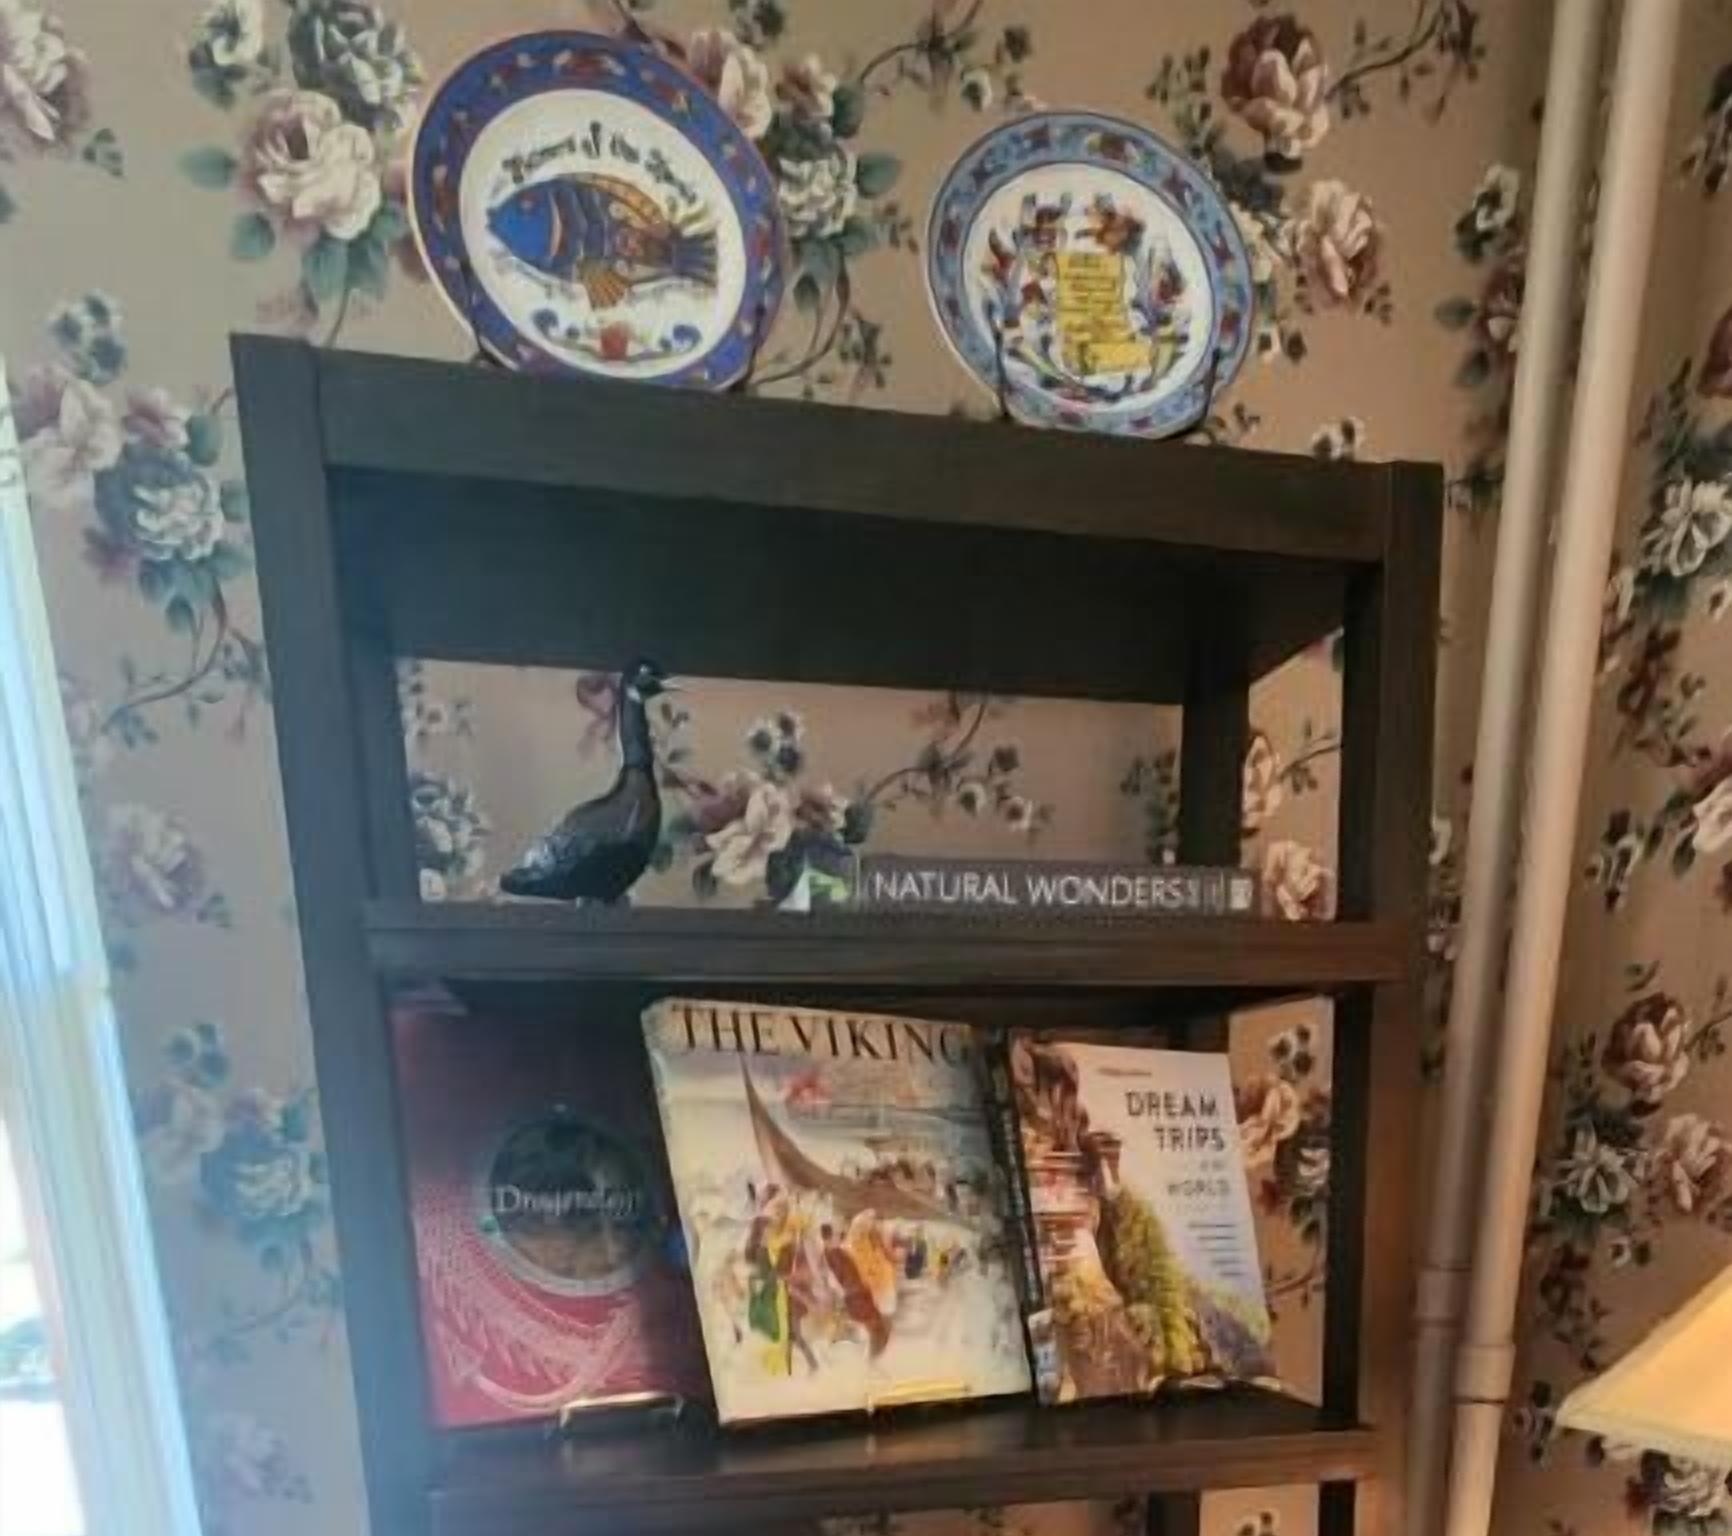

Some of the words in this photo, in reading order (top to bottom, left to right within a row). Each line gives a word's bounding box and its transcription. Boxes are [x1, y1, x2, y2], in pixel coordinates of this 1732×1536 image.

[875, 872, 1017, 905] NATURAL
[1026, 875, 1182, 909] WONDERS
[672, 1003, 780, 1056] THE
[1124, 1090, 1218, 1118] DREAM
[1153, 1127, 1226, 1152] TRIPS
